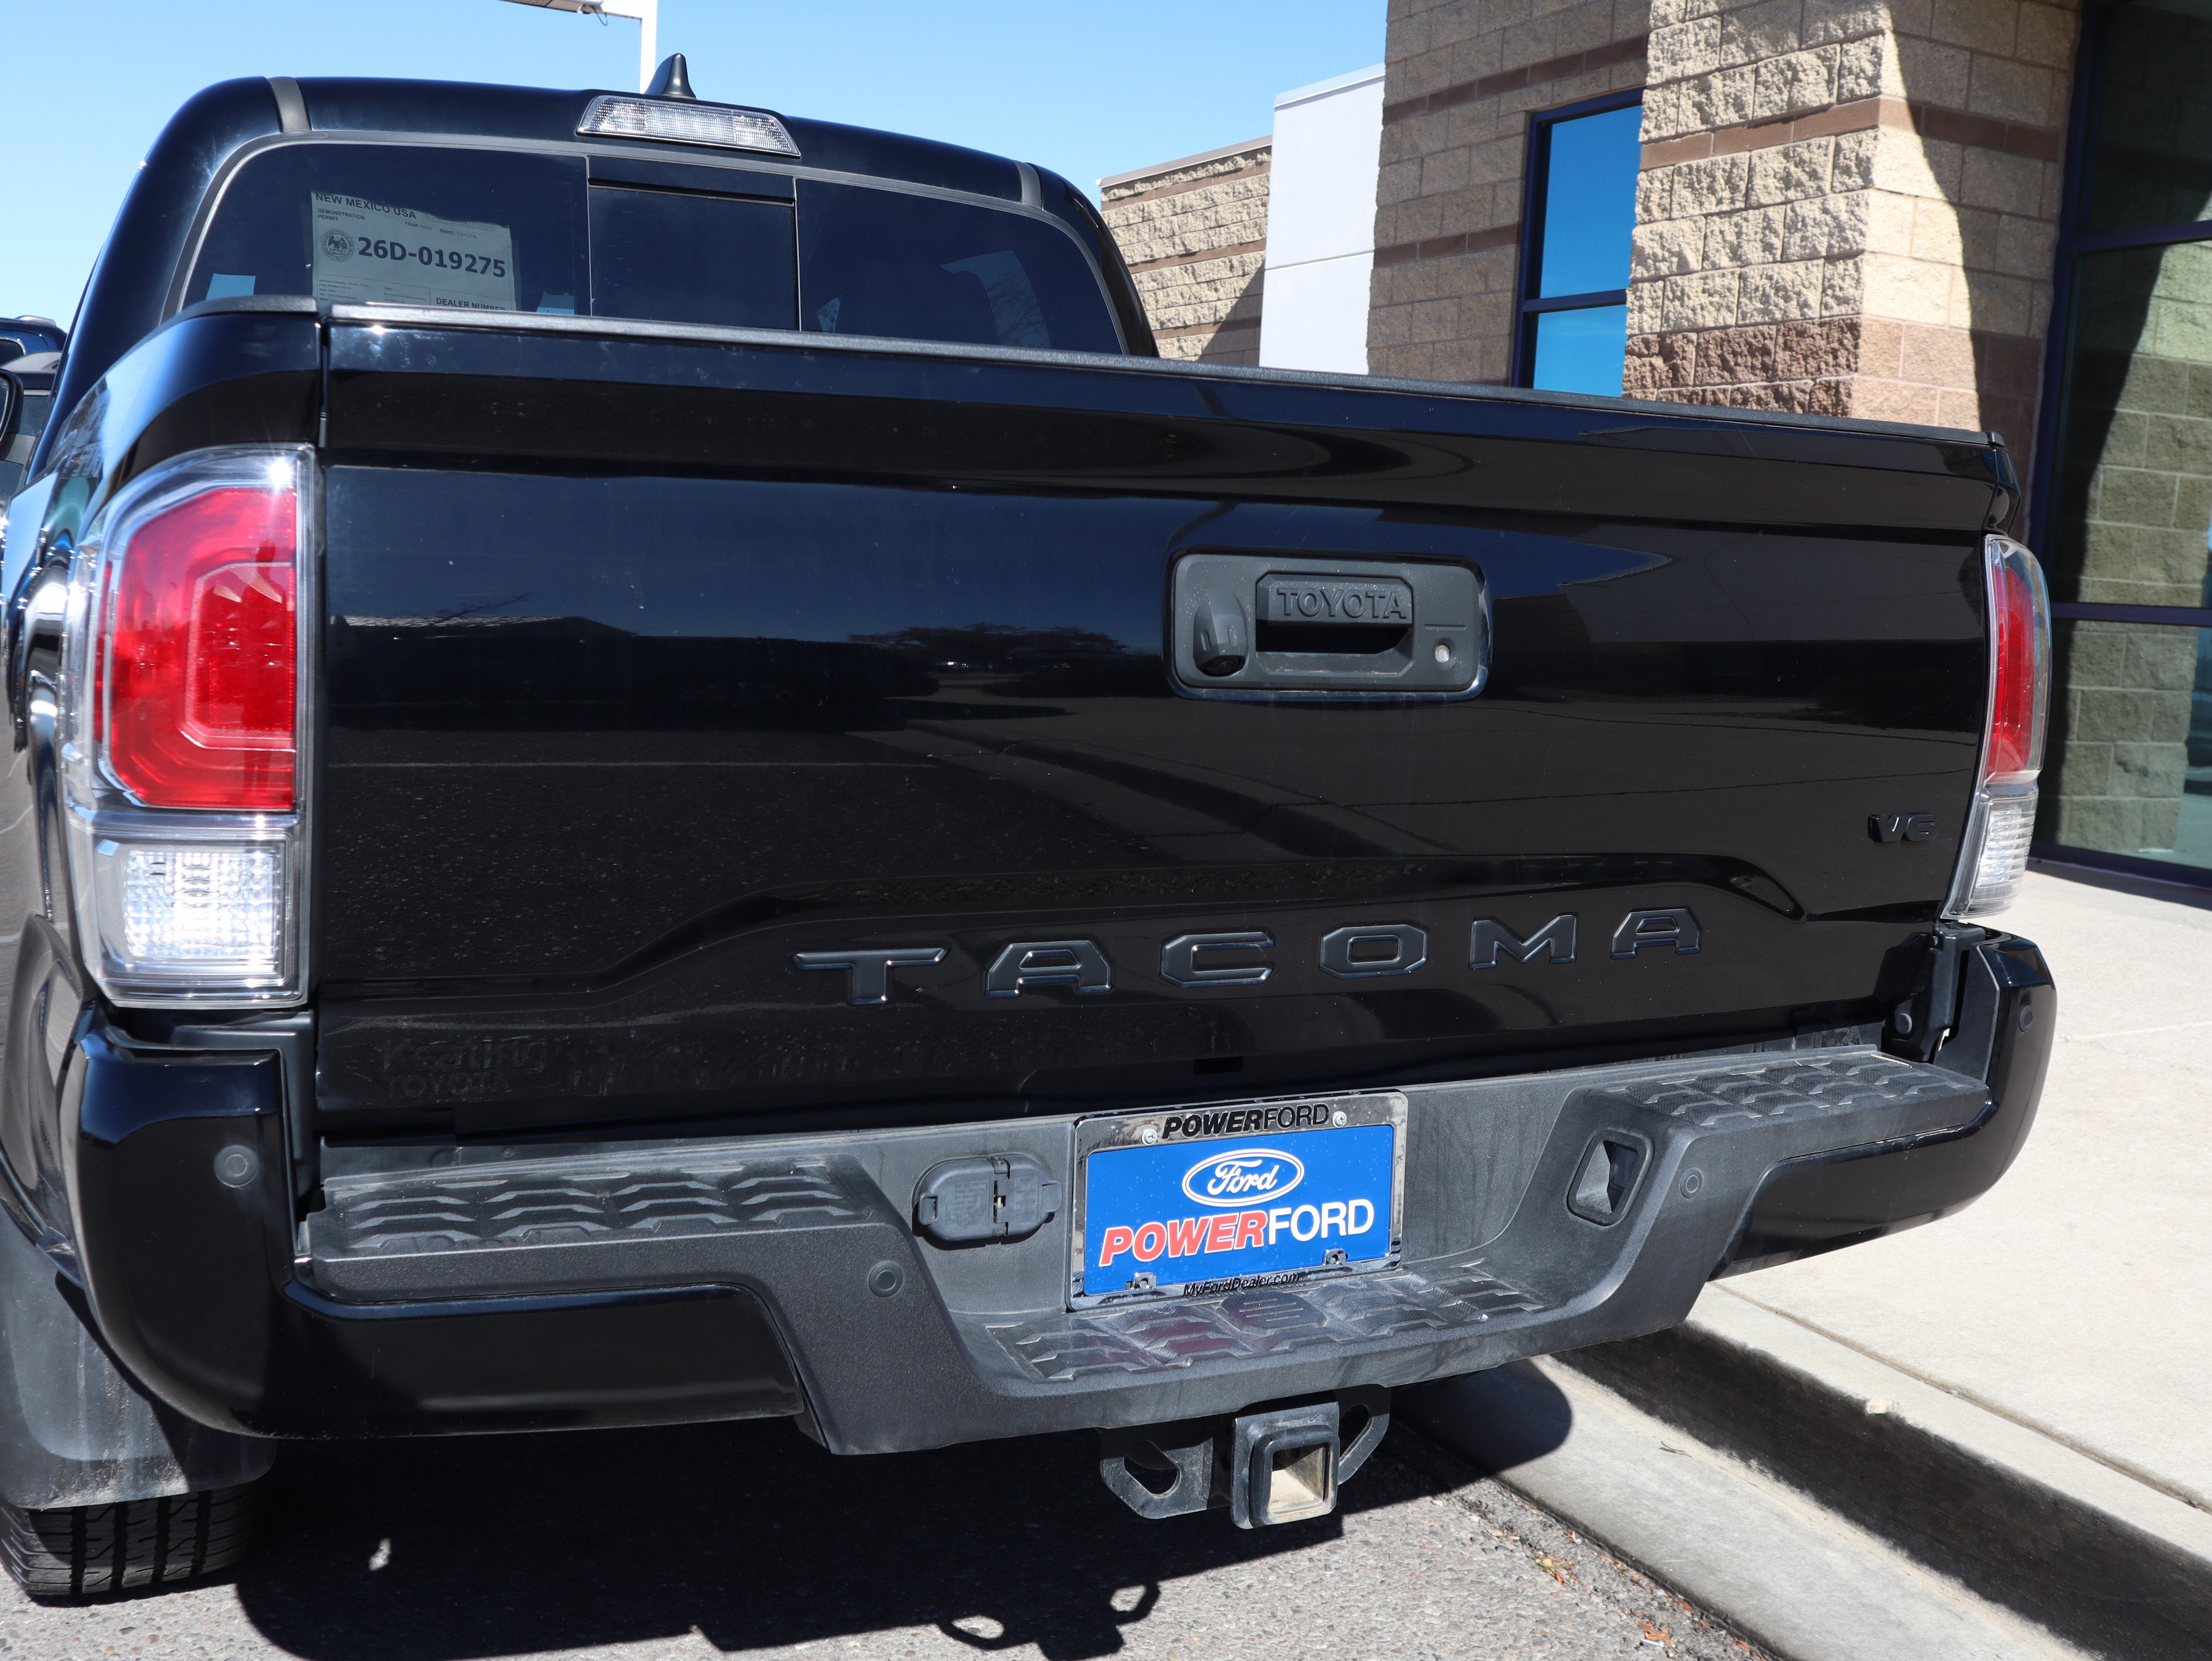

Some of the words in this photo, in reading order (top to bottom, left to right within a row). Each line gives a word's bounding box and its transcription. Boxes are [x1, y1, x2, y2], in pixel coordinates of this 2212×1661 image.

[316, 193, 342, 204] NEW
[346, 198, 390, 213] MEXICO
[394, 207, 417, 219] USA
[318, 208, 365, 220] DEMONSTRATION
[357, 237, 506, 278] 26D-019275
[436, 297, 469, 308] DEALER
[1276, 587, 1408, 620] TOYOTA
[1867, 811, 1939, 843] V6
[792, 906, 1702, 1007] TACOMA
[1162, 1103, 1330, 1140] POWERFORD
[1207, 1160, 1278, 1195] Ford
[1099, 1198, 1375, 1267] POWERFORD
[1182, 1272, 1300, 1298] MyFordDealer.com
